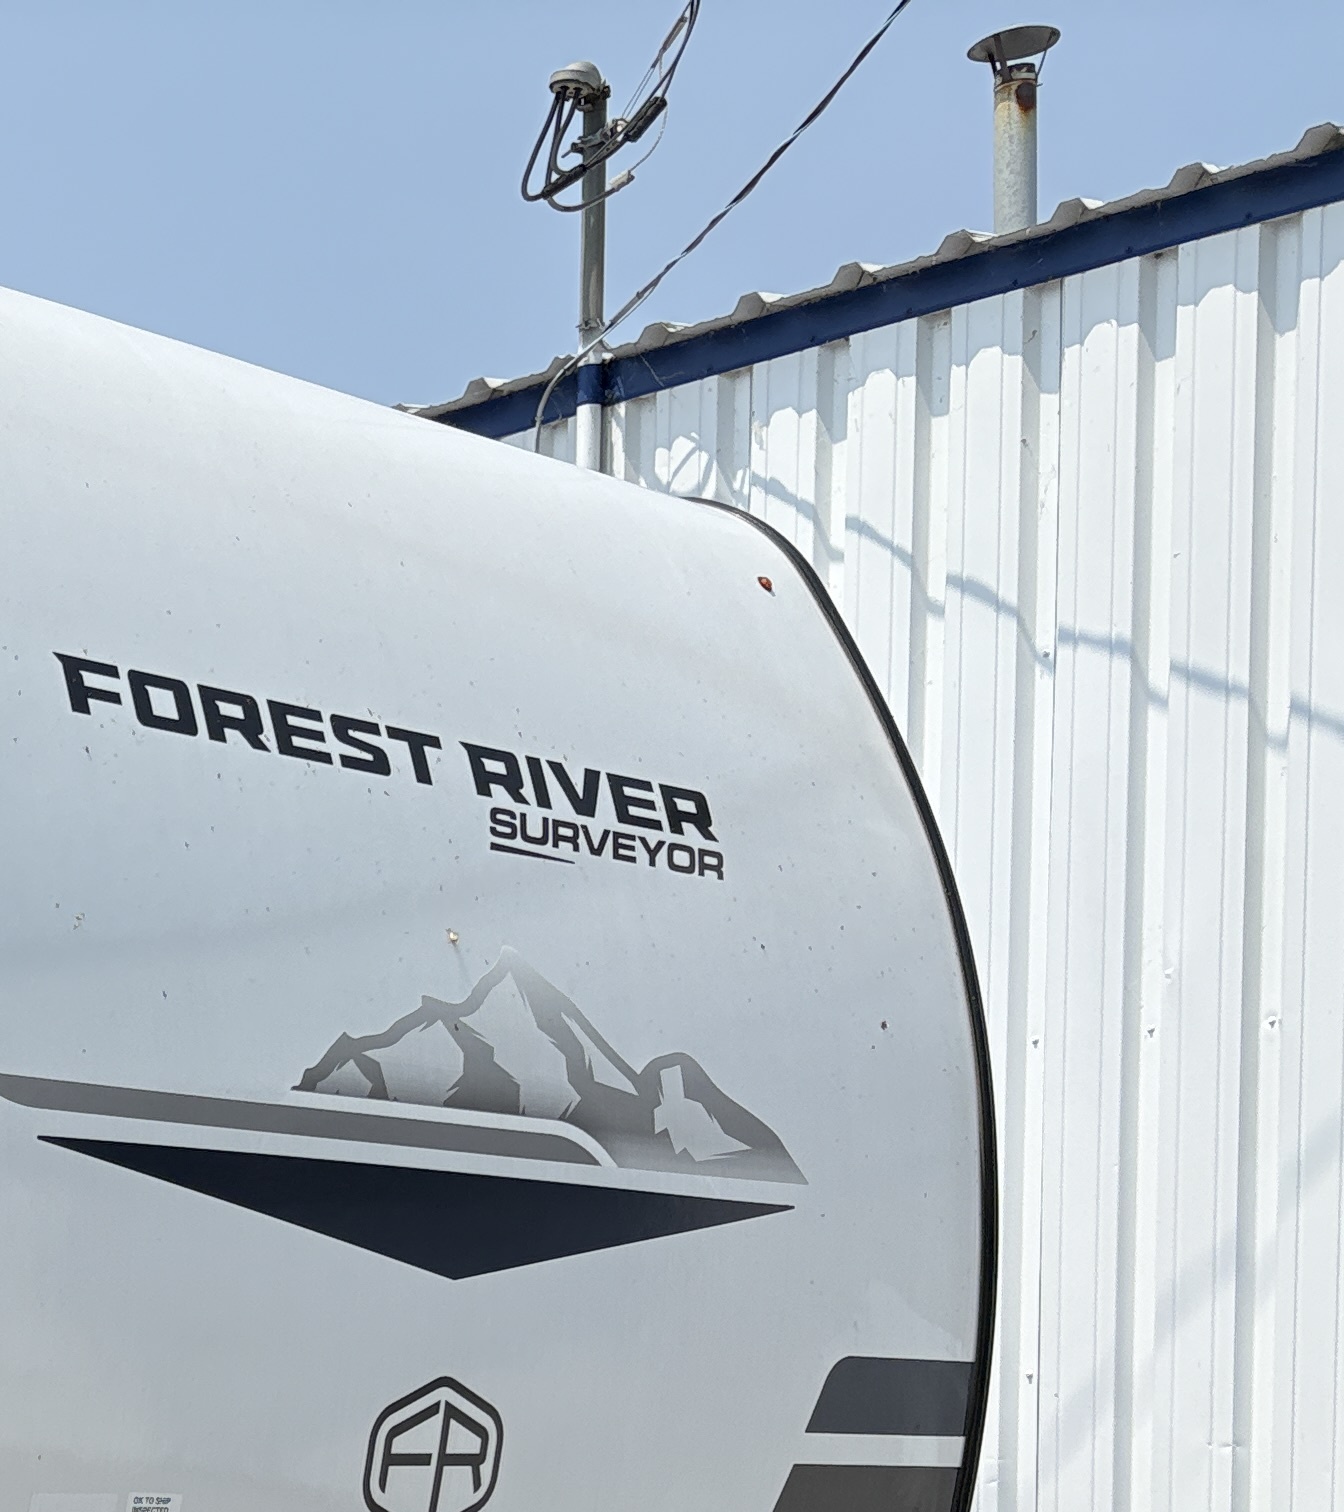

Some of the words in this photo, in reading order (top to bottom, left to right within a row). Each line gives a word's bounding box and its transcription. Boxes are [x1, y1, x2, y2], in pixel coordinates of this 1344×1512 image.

[52, 652, 442, 786] FOREST
[459, 740, 719, 843] RIVER
[489, 807, 725, 880] SURVEYOR
[145, 1496, 155, 1504] TO
